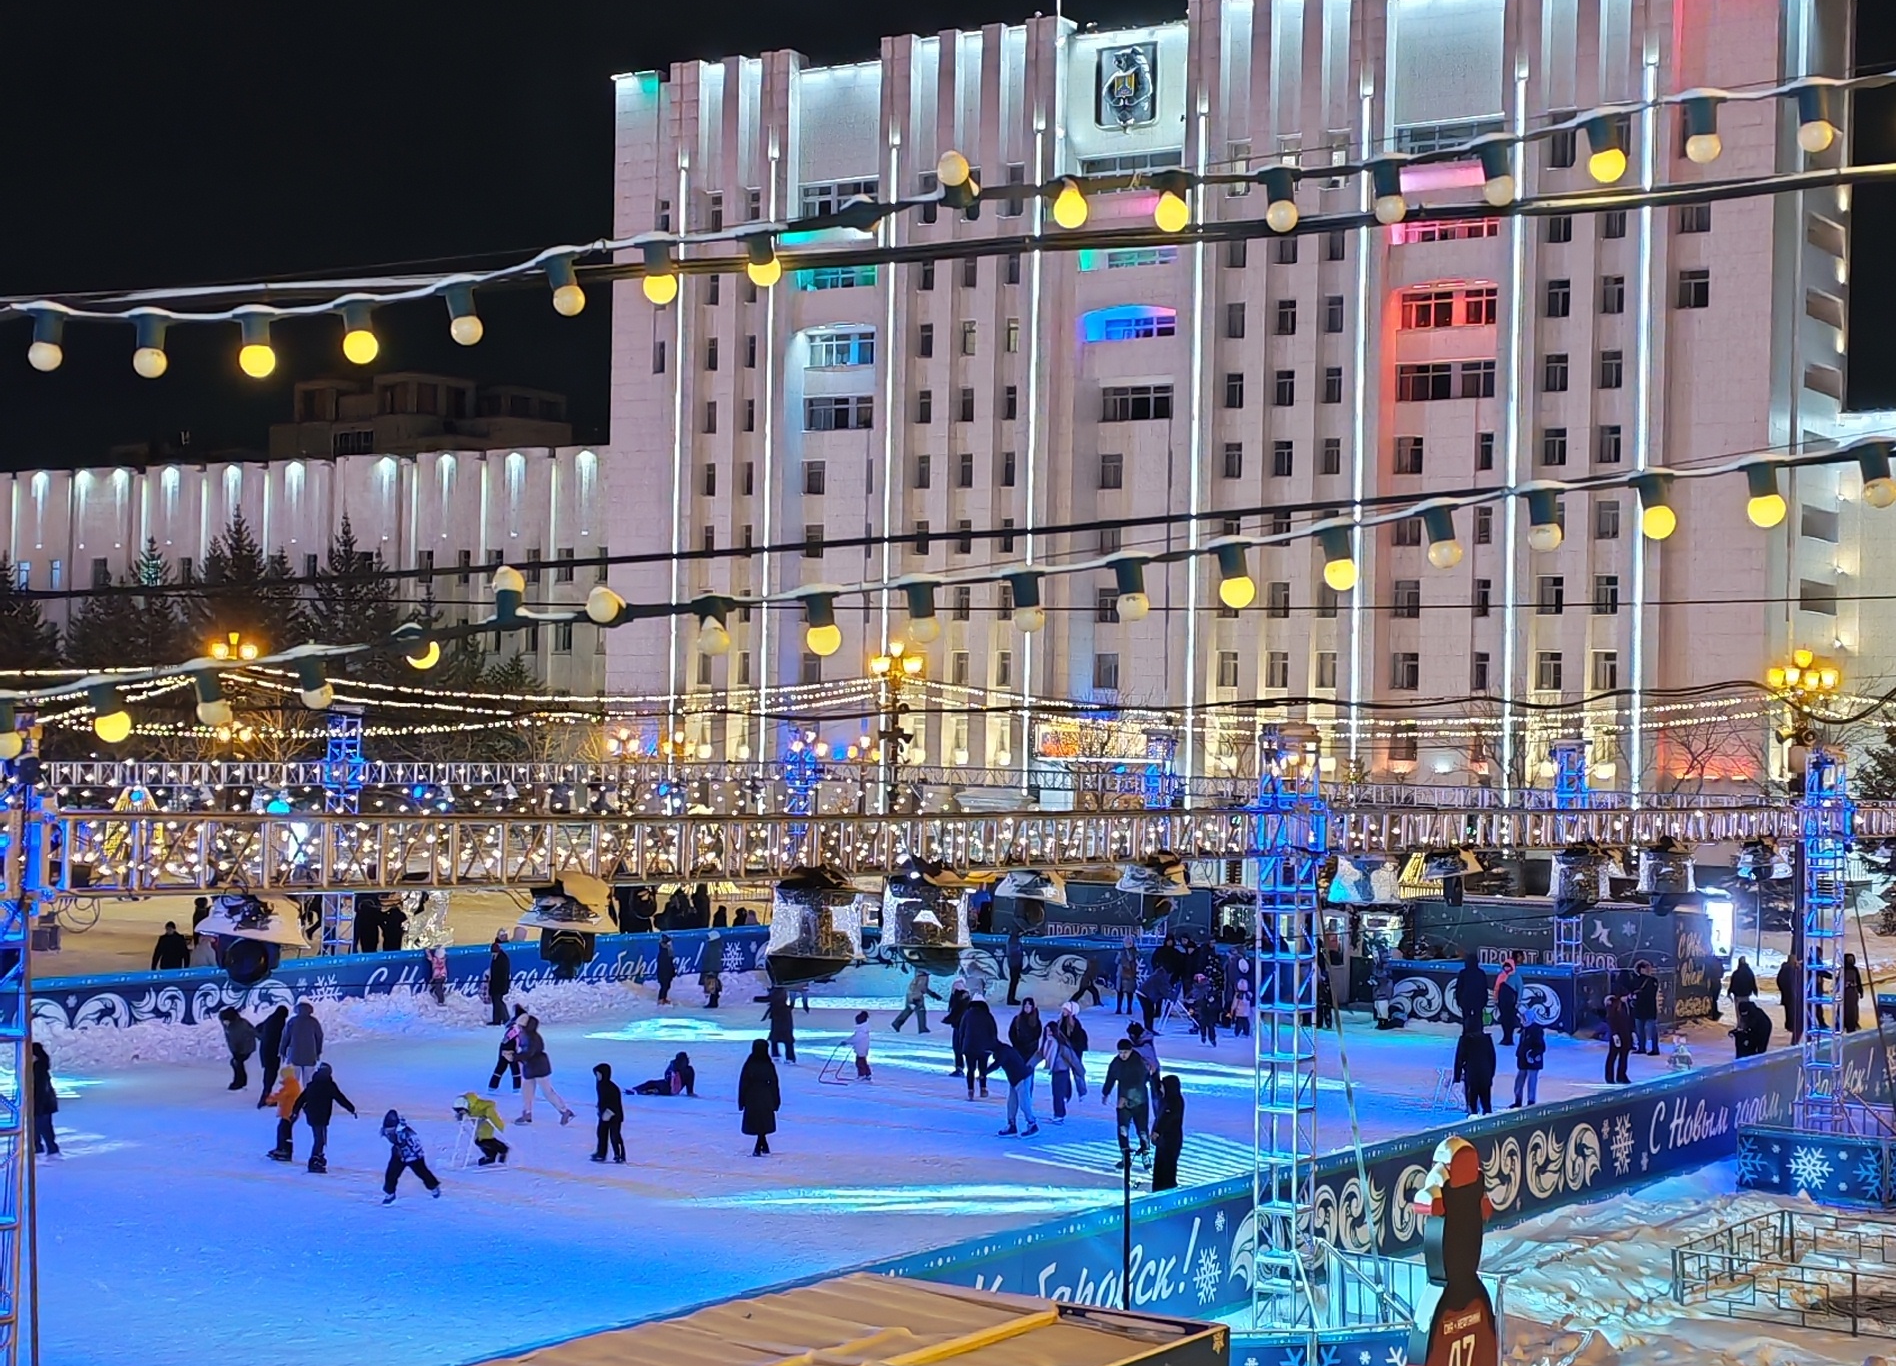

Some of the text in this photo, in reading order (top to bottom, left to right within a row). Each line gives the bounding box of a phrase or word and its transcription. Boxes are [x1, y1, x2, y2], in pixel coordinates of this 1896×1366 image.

[1478, 946, 1539, 966] ПРОАТ
[1649, 1100, 1667, 1155] С
[1668, 1096, 1729, 1151] Новым
[974, 1216, 1201, 1311] баровск!
